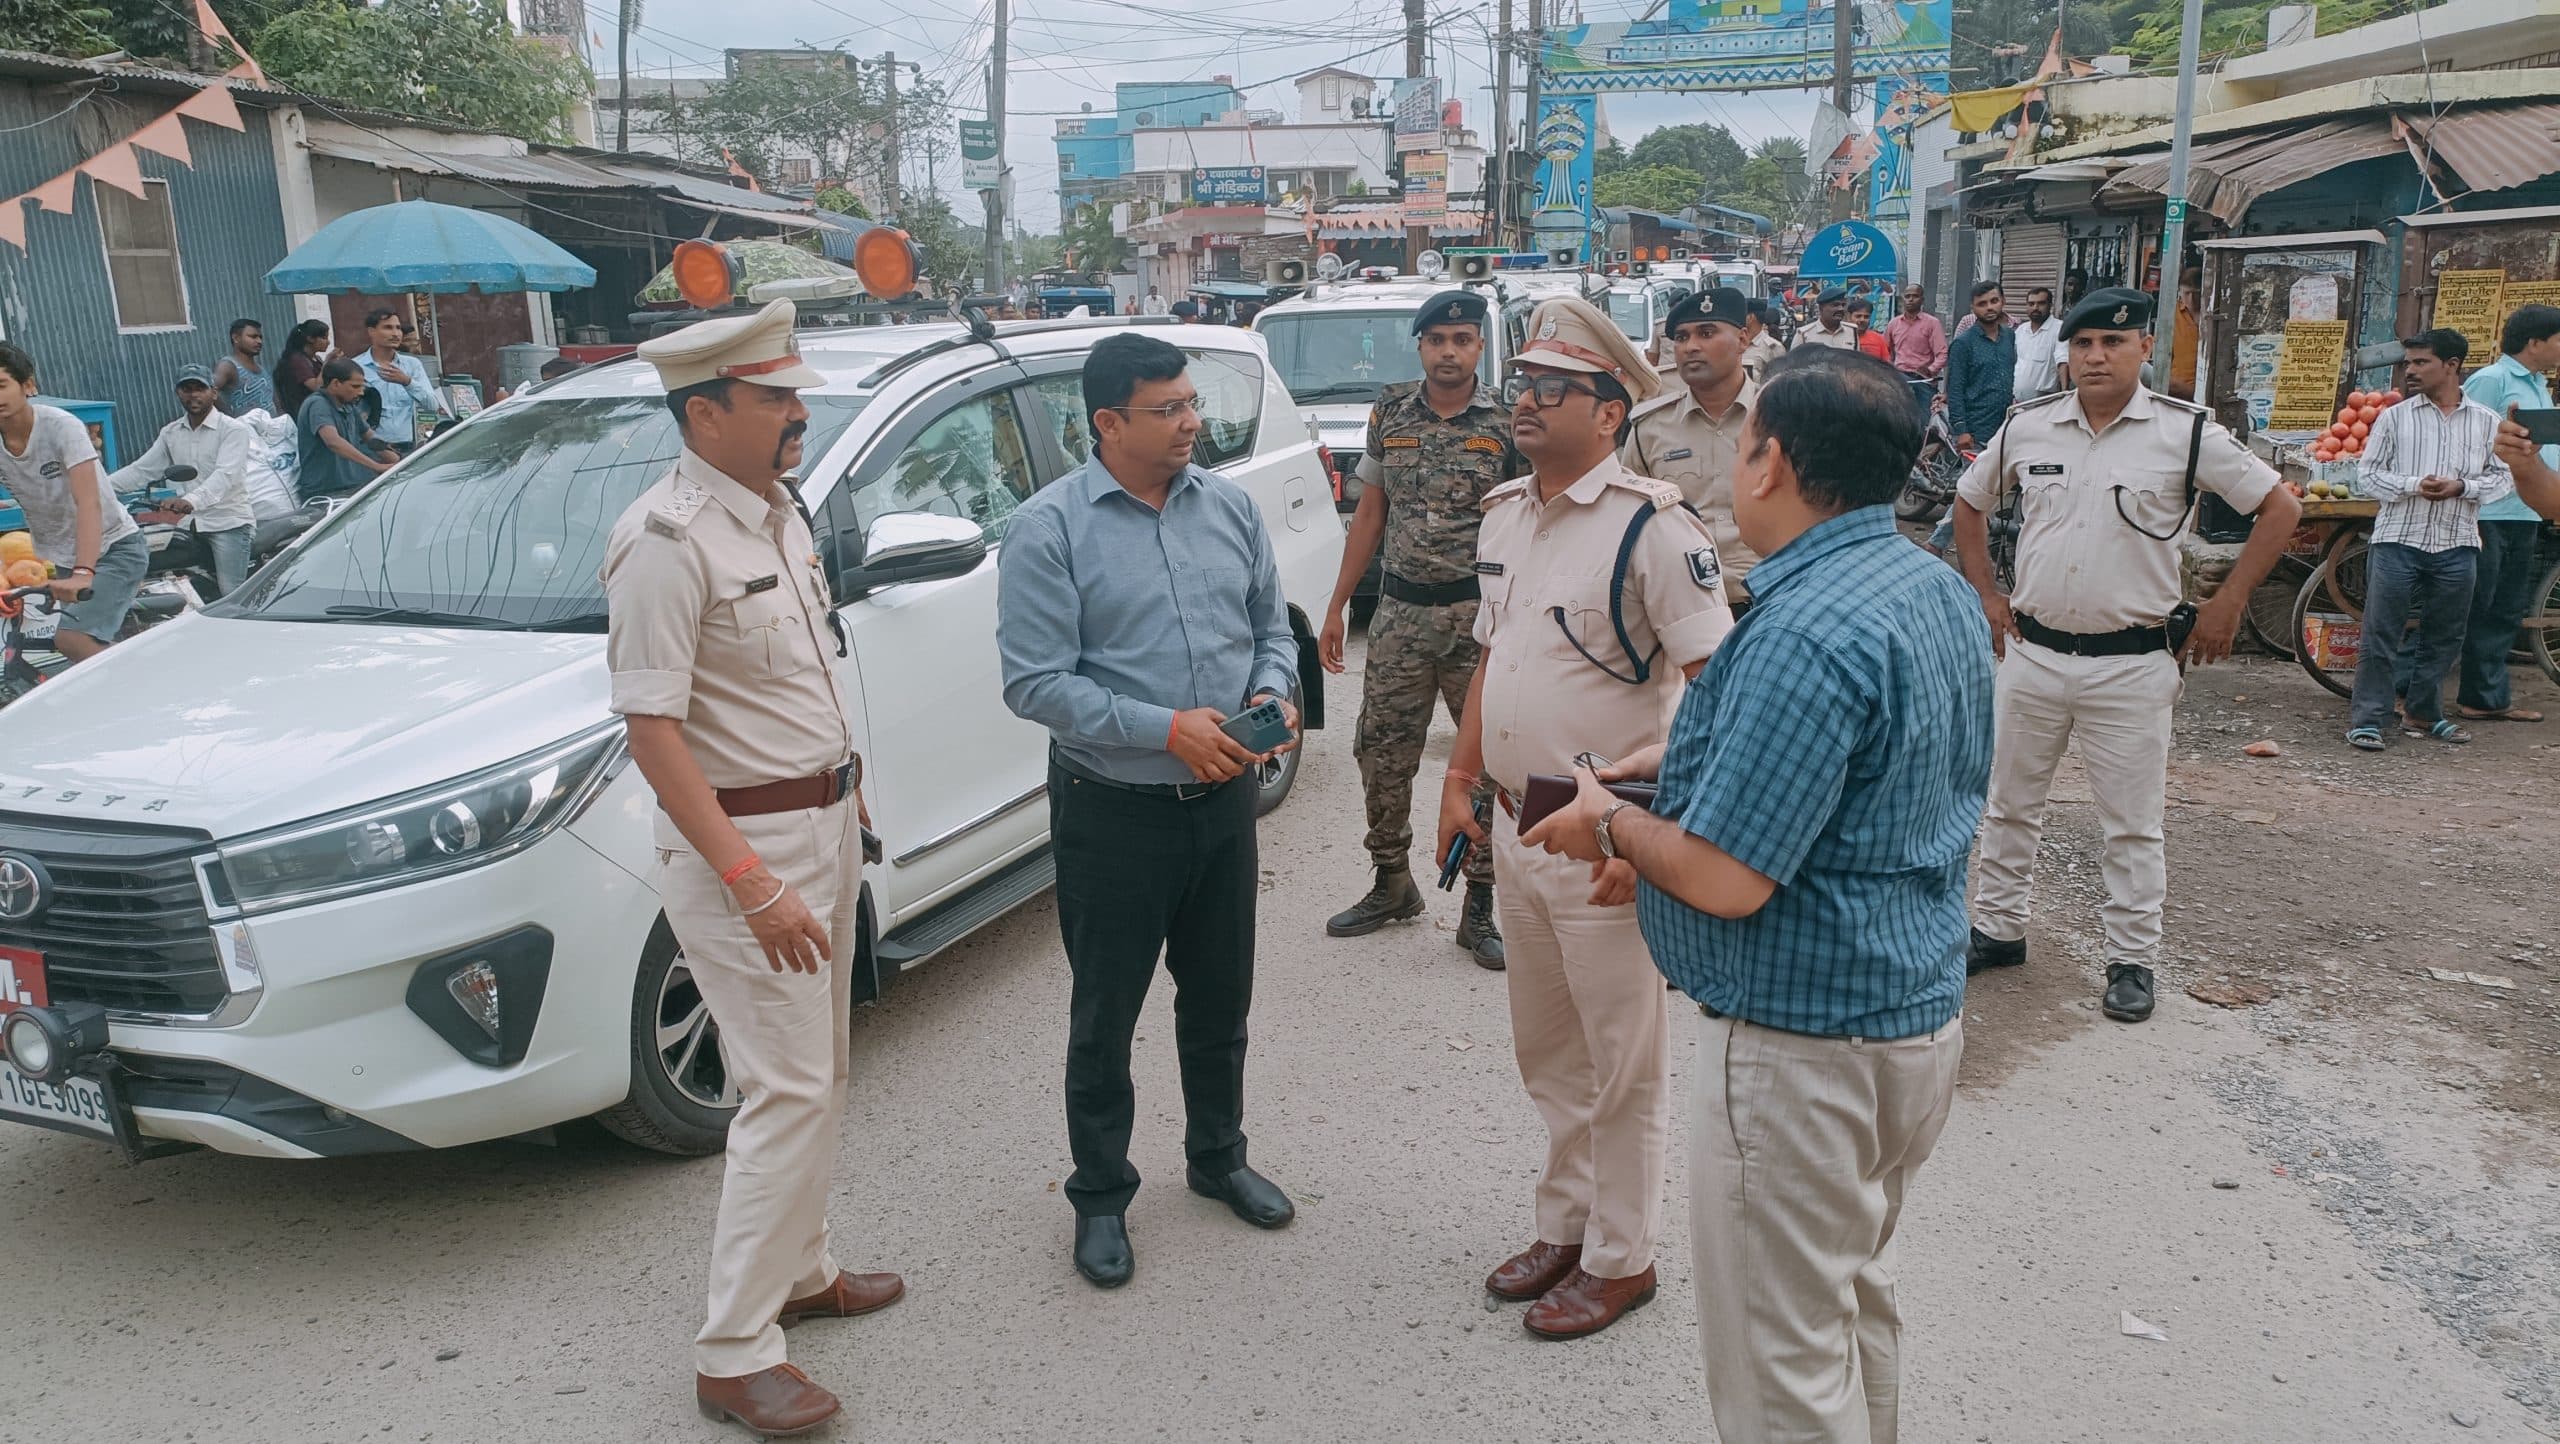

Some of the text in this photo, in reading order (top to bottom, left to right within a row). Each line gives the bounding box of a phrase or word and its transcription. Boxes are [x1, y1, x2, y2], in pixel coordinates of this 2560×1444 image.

[1197, 179, 1261, 194] श्री मेडिकल
[1829, 241, 1865, 257] Cream
[1837, 251, 1858, 266] Bell
[37, 625, 55, 637] AGRO
